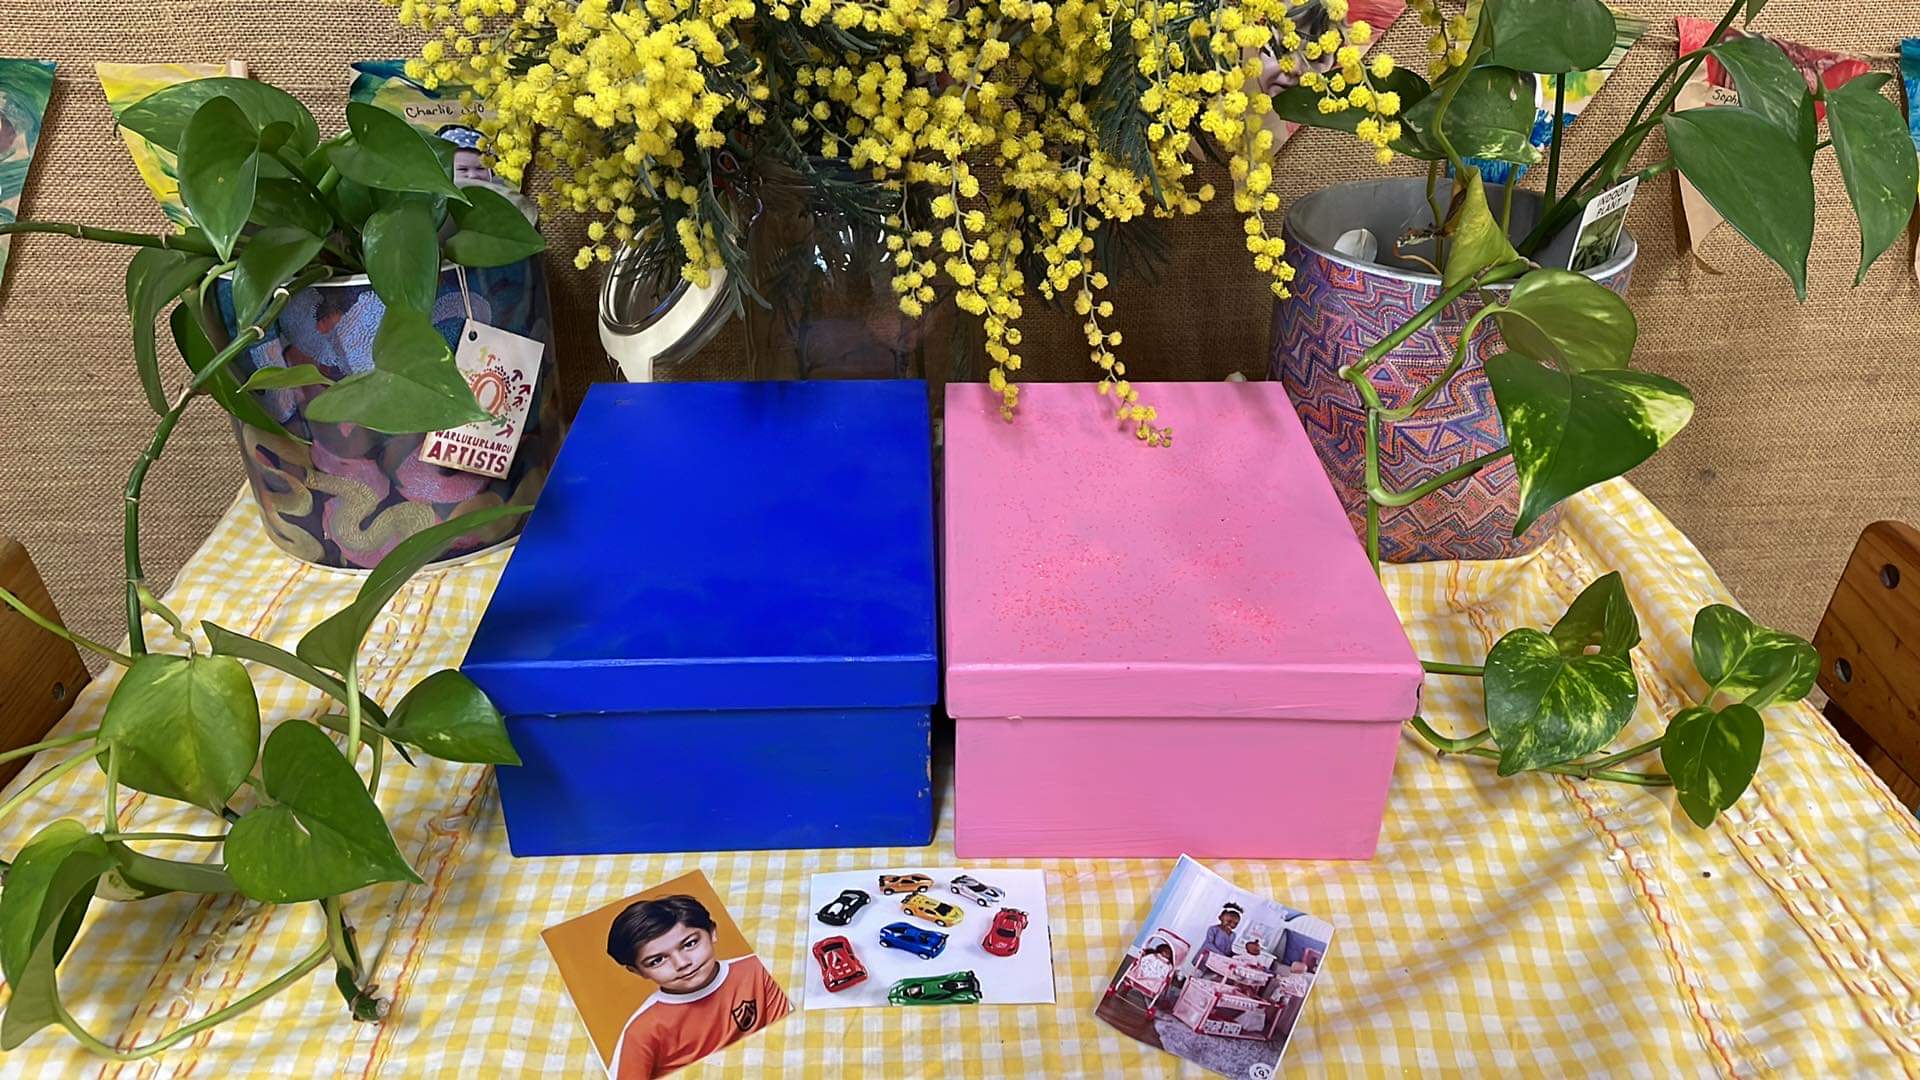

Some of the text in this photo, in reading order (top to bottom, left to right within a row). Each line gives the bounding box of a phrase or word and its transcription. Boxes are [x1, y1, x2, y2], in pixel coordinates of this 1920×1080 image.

[405, 104, 454, 118] Charlie
[1596, 197, 1623, 217] PLANT
[1597, 184, 1629, 208] INDOOR
[427, 440, 508, 473] ARTISTS
